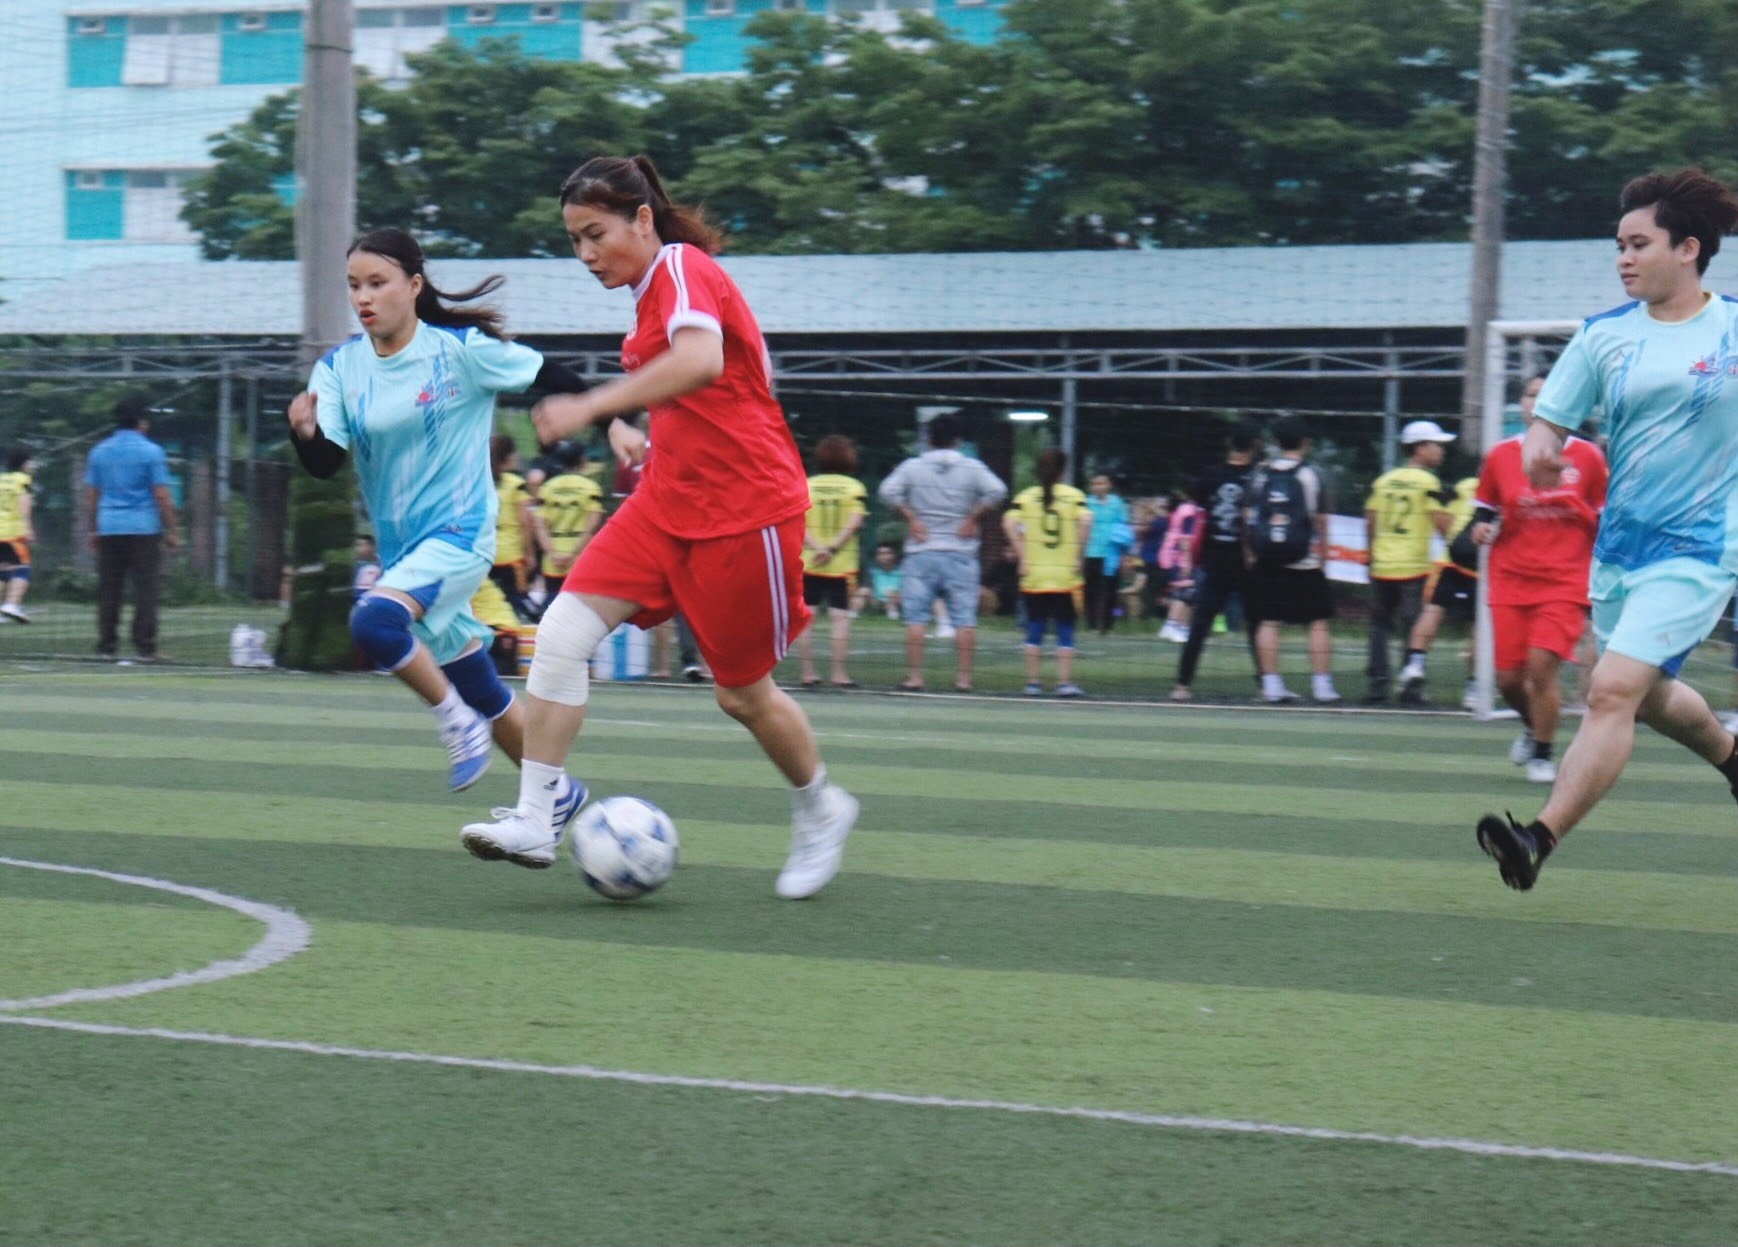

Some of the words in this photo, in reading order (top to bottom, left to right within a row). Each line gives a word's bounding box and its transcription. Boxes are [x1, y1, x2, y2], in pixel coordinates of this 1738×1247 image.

[549, 500, 585, 537] 22
[819, 499, 841, 537] 11
[1041, 509, 1063, 549] 9
[1384, 492, 1413, 534] 12
